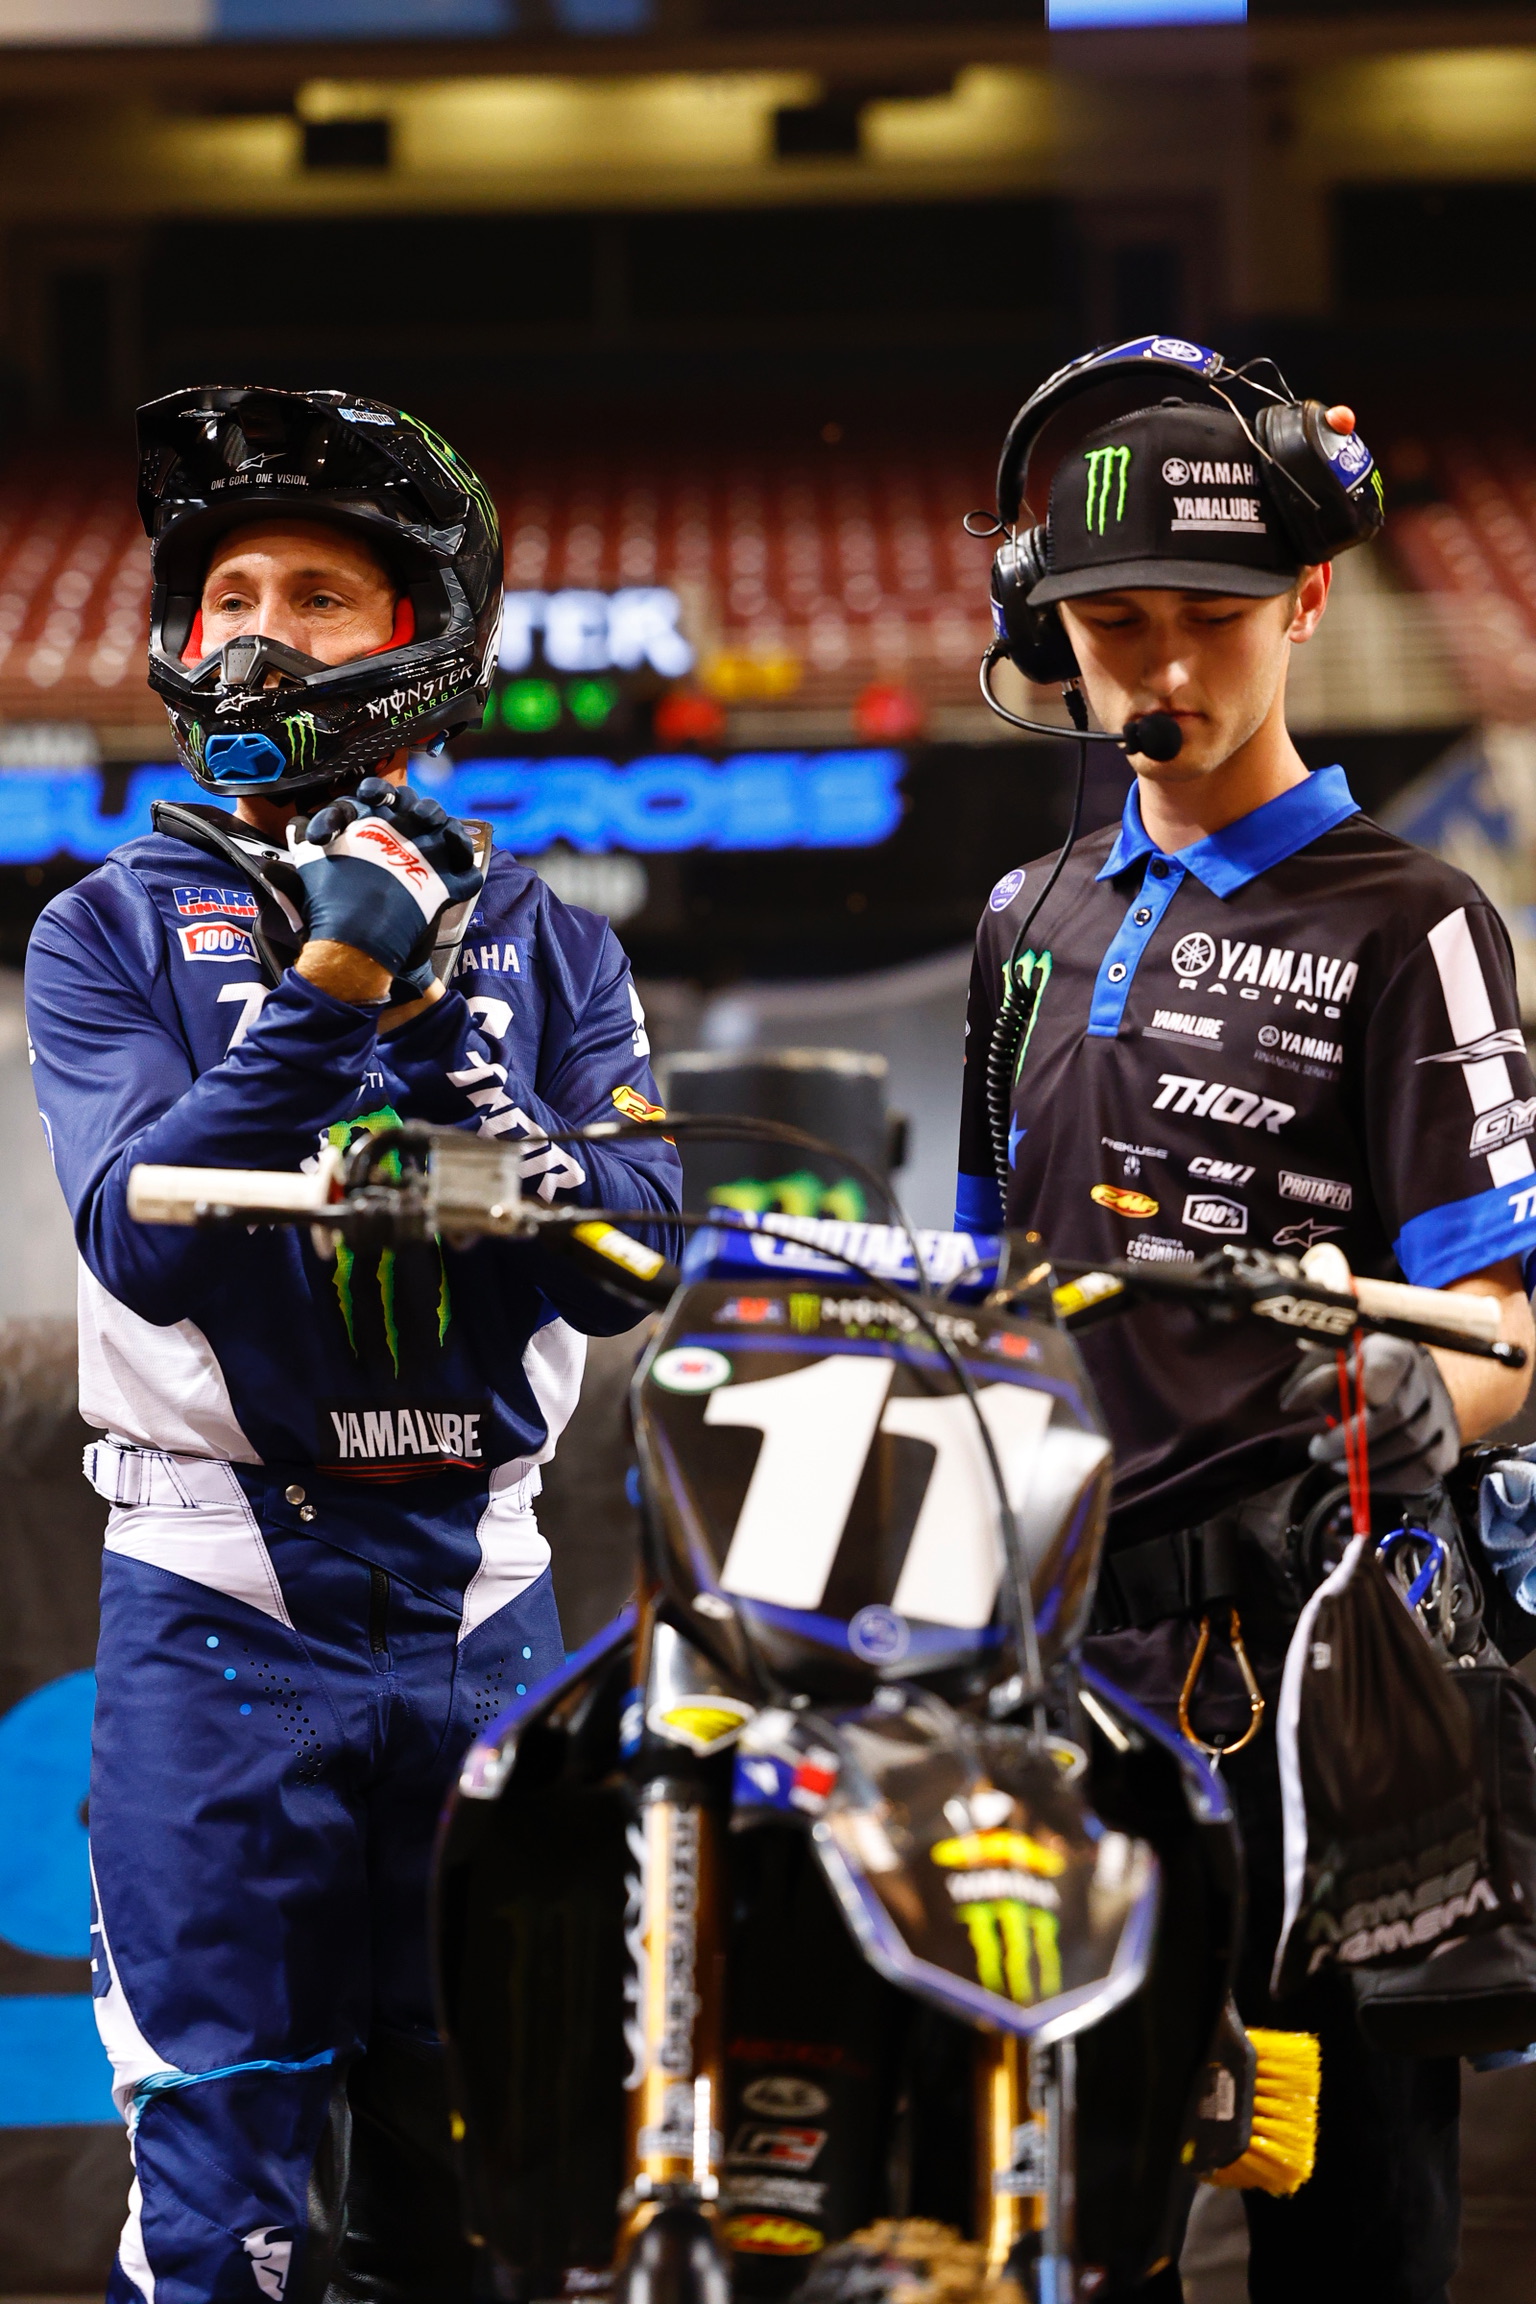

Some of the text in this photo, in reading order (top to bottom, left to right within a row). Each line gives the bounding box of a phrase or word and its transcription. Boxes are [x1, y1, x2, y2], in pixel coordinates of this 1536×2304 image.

[211, 473, 310, 490] ONE GOAL. ONE VISION.
[1189, 461, 1259, 486] YAMAH
[1173, 497, 1261, 521] YAMALUBE
[366, 663, 475, 719] MONSTER
[391, 686, 460, 726] ENERGY
[192, 928, 250, 953] 100%
[1218, 939, 1359, 1004] YAMAHA
[1178, 978, 1342, 1019] RACING
[1151, 1009, 1225, 1041] YAMALUBE
[1281, 1030, 1343, 1064] YAMAHA
[1152, 1073, 1296, 1134] THOR
[1284, 1175, 1351, 1210] PROTAPER
[1192, 1202, 1241, 1228] 100%
[330, 1409, 482, 1458] YAMALUBE
